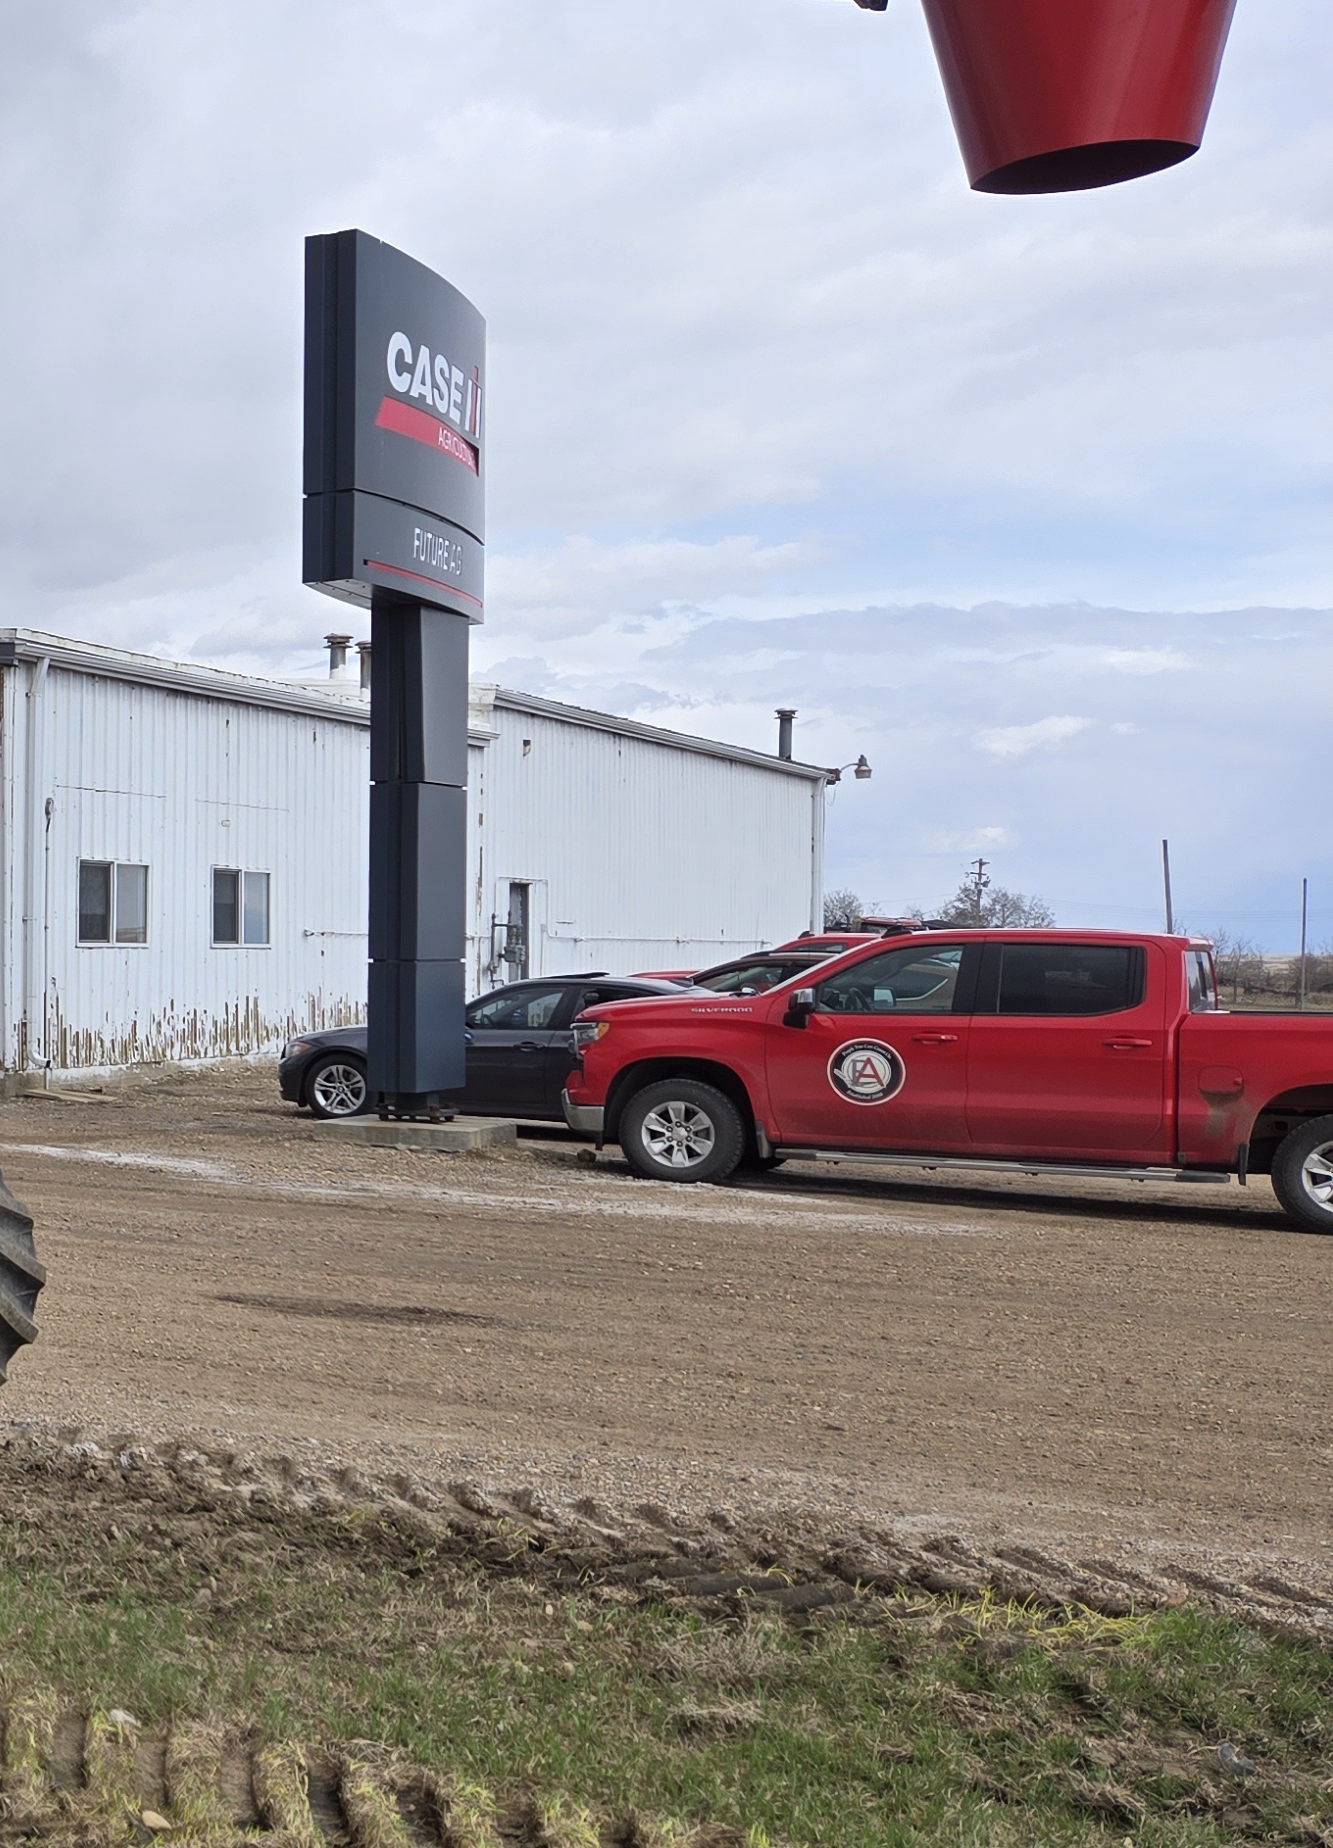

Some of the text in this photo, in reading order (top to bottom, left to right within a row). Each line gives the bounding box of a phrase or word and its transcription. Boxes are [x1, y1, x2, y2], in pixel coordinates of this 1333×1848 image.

[386, 331, 465, 425] CASE
[413, 527, 462, 576] FUTURE AG
